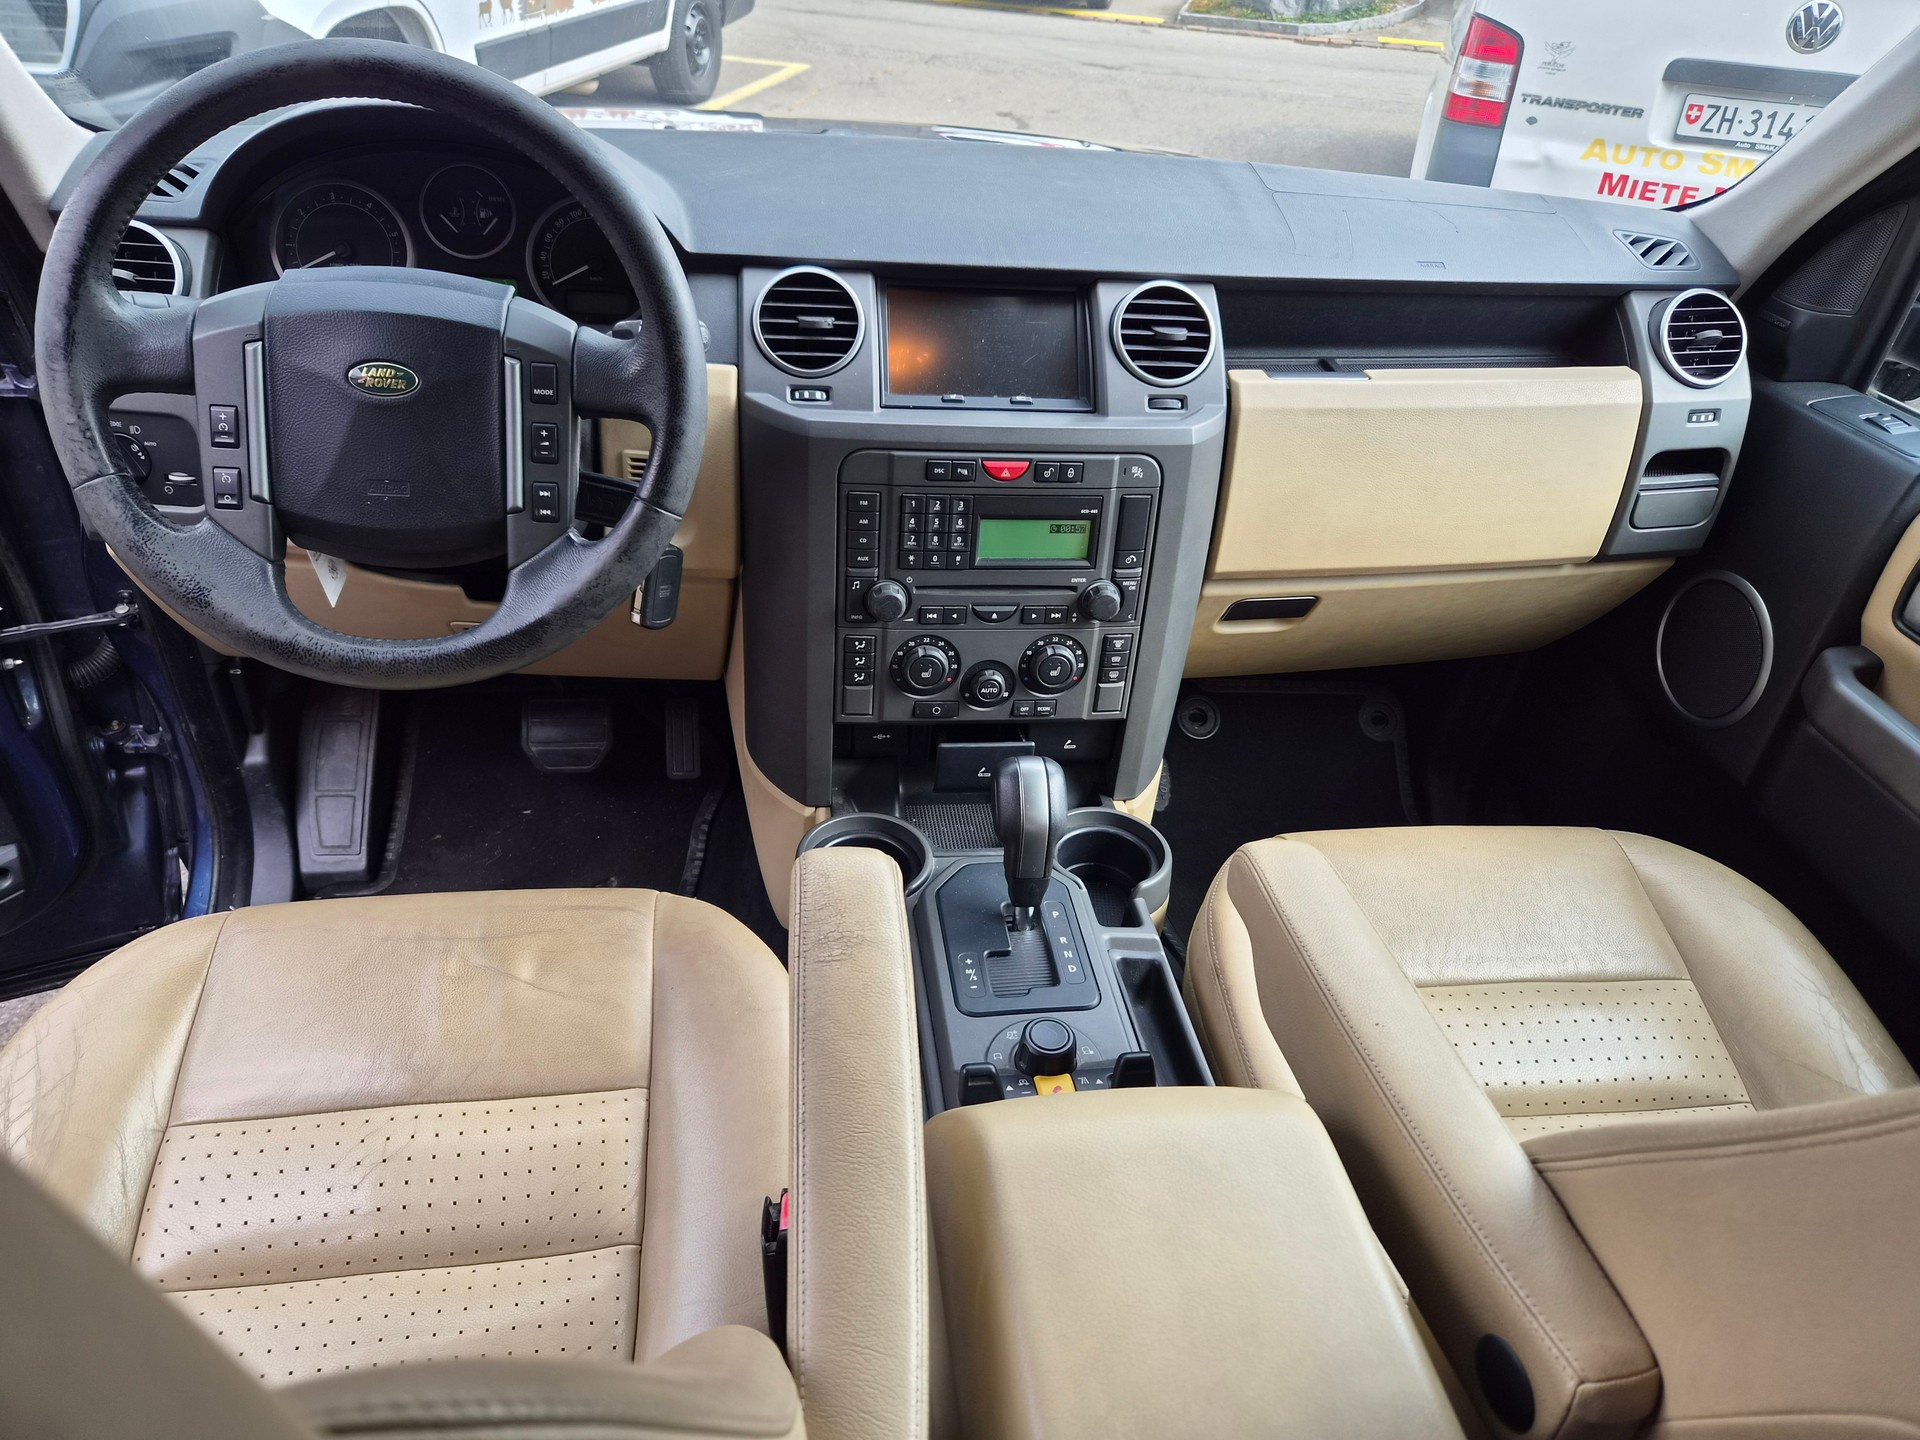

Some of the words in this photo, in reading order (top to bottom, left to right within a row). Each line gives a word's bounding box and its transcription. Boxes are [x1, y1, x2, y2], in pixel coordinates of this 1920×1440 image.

[1521, 93, 1645, 119] TRANSPORTER
[1735, 141, 1751, 149] Auto
[1581, 137, 1685, 171] AUTO
[1597, 172, 1700, 206] MIETE
[361, 366, 396, 378] LAND
[364, 377, 407, 390] ROVER
[533, 388, 554, 396] MODE
[909, 517, 915, 525] 4
[934, 517, 940, 525] 5
[957, 518, 963, 526] 6
[933, 535, 938, 543] 8
[1051, 910, 1060, 919] P
[1059, 936, 1068, 945] R
[1063, 950, 1073, 959] N
[1068, 965, 1077, 973] D
